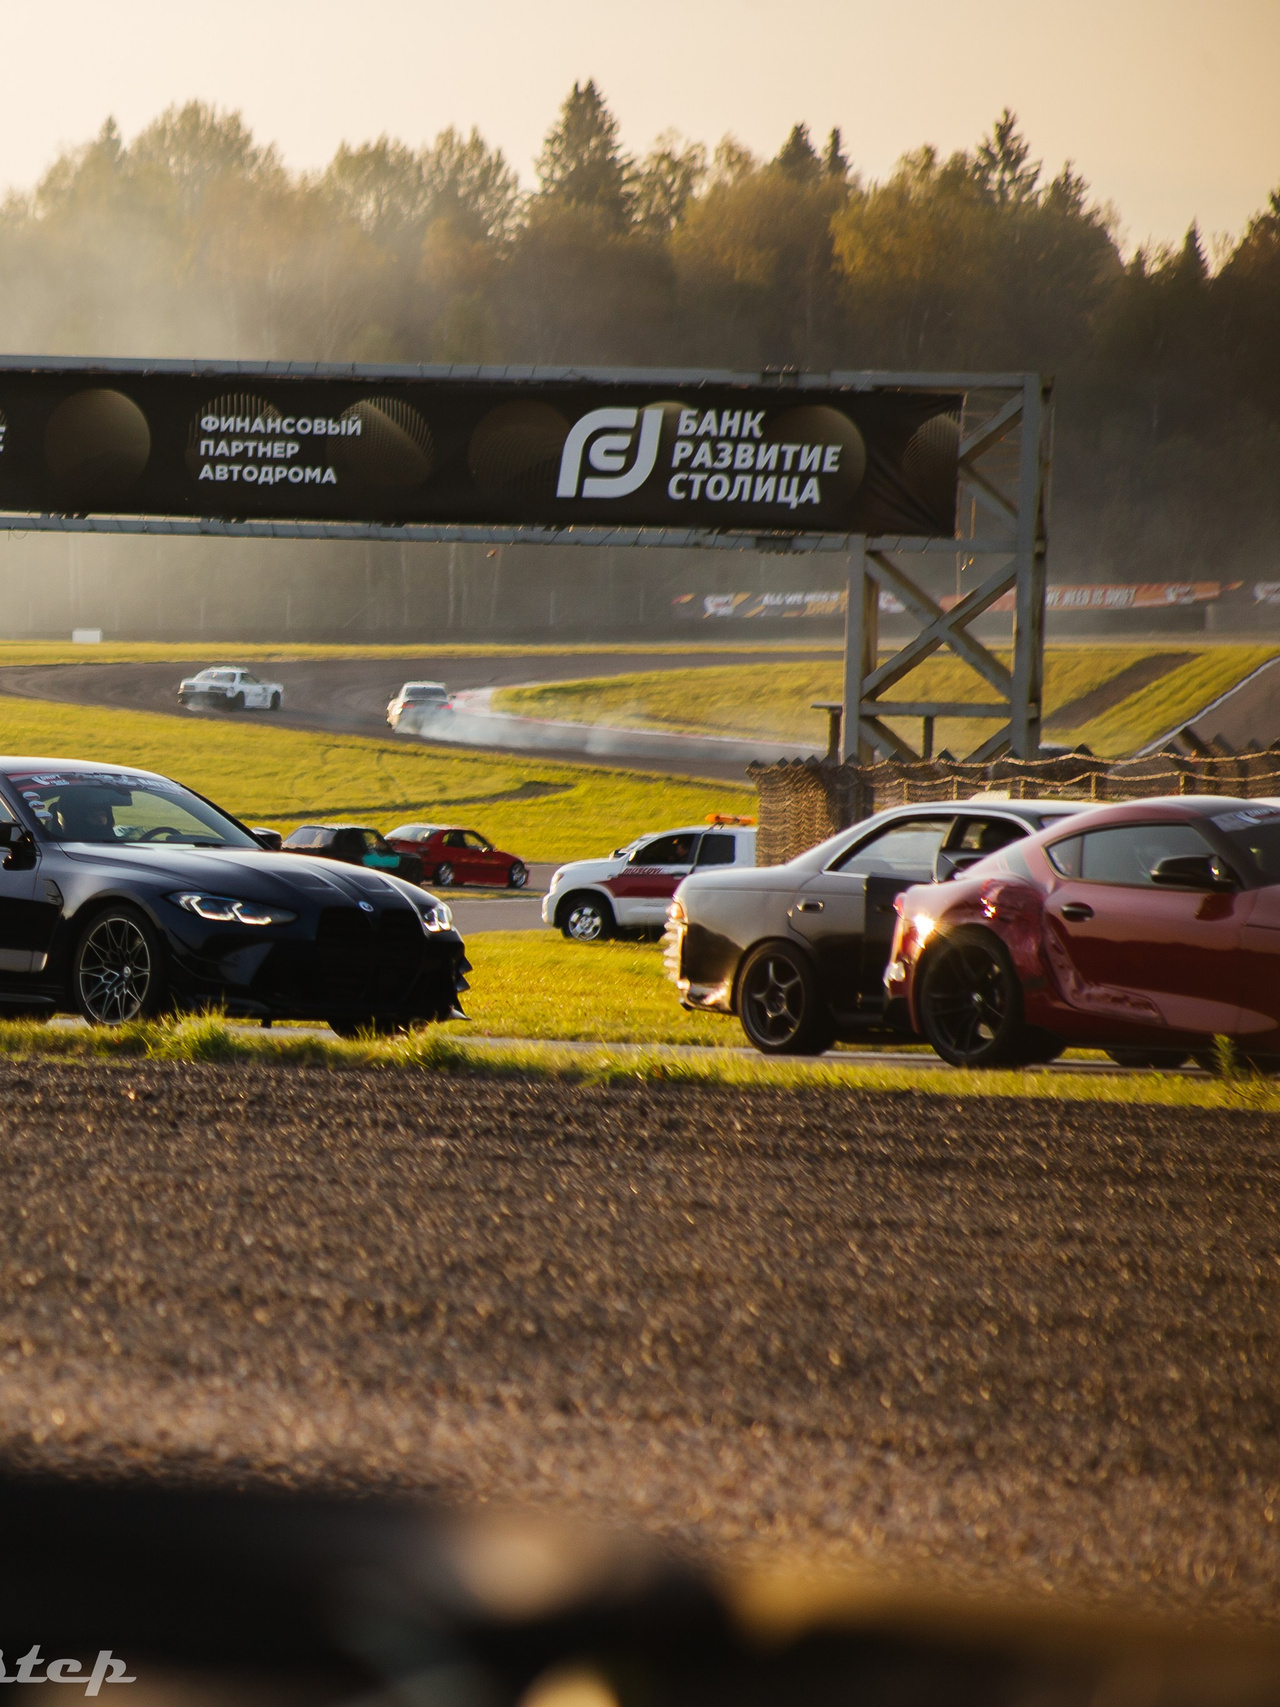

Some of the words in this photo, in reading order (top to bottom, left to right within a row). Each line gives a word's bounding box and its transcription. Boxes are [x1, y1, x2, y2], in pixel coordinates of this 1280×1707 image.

[200, 415, 363, 436] ФИНАНСОВЫЙ
[677, 410, 766, 438] БАНК
[199, 440, 300, 459] ПАРТНЕР
[671, 442, 842, 474] РАЗВИТИЕ
[198, 464, 337, 485] АВТОДРОМА
[667, 473, 821, 509] СТОЛИЦА
